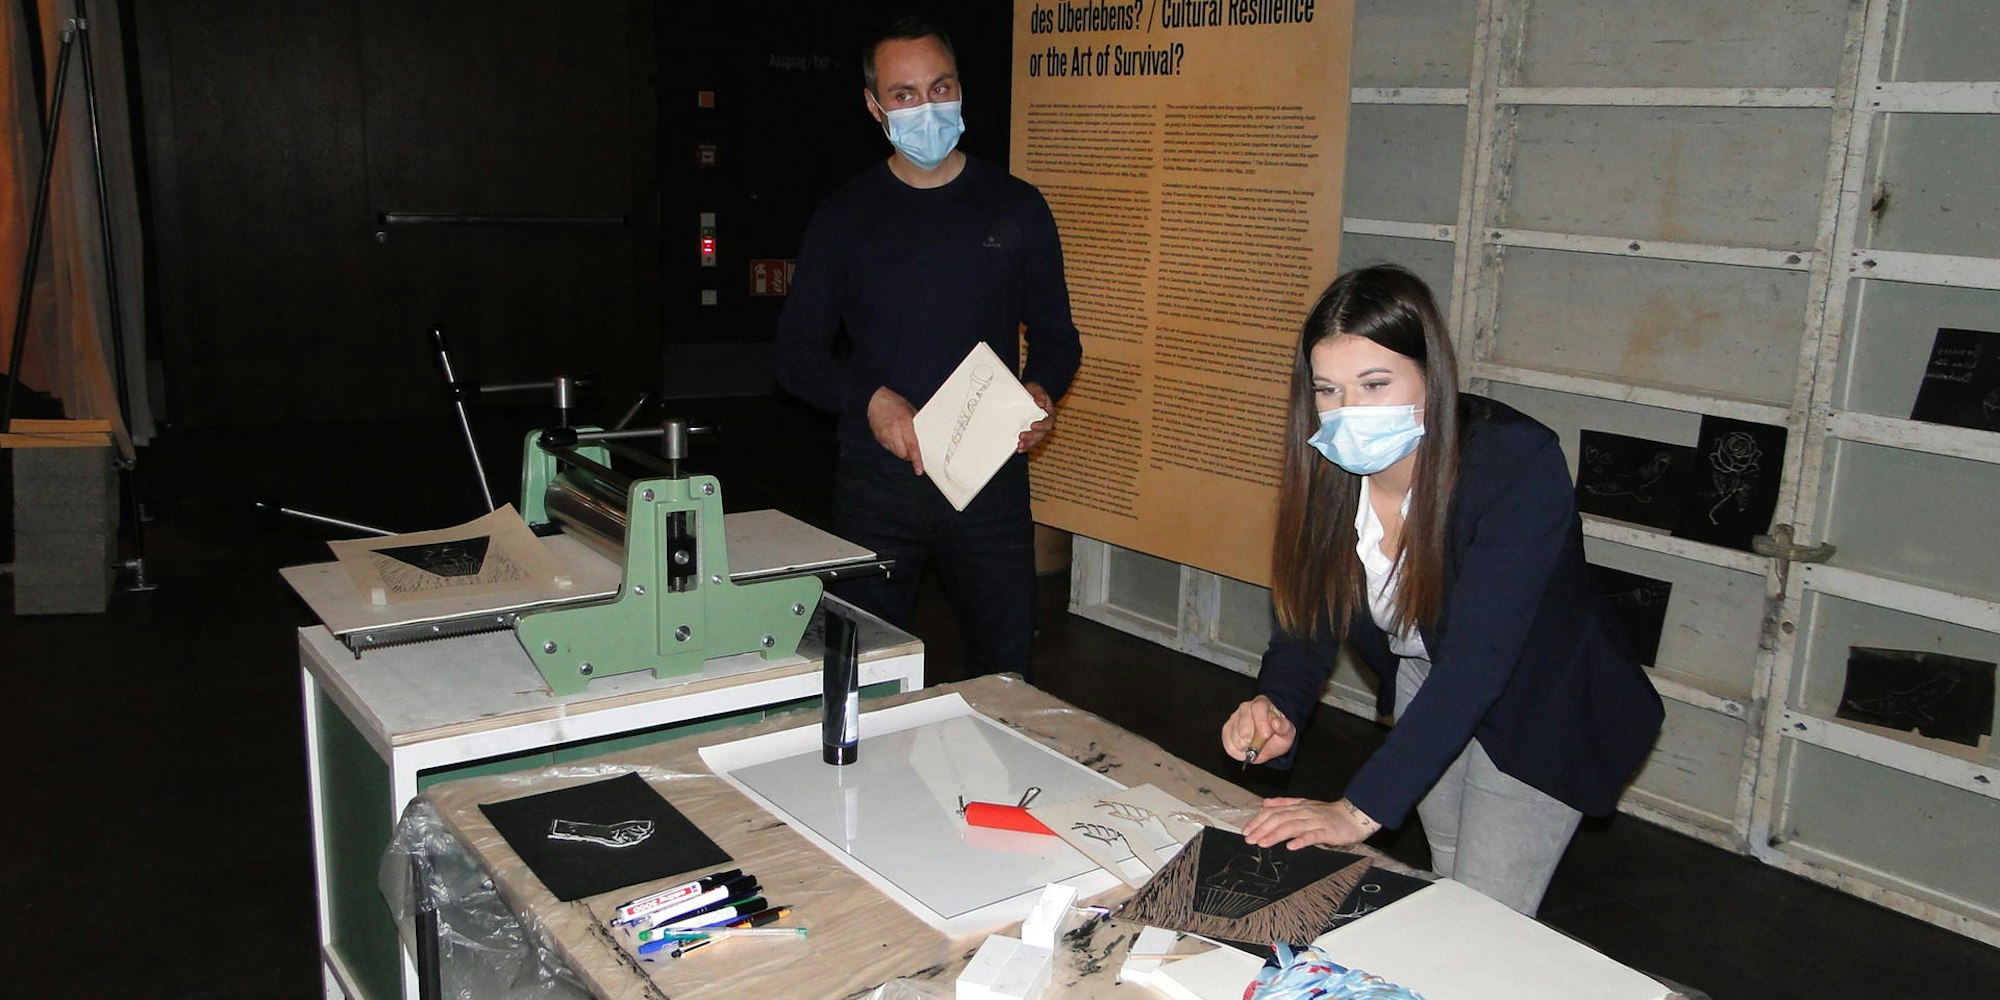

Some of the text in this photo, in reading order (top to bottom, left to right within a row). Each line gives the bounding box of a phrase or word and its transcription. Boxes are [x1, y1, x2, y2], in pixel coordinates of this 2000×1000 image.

[1031, 3, 1054, 34] des
[1162, 0, 1223, 29] Cultural
[1228, 0, 1315, 26] Resilience
[1029, 42, 1185, 77] or the Art of Survival?
